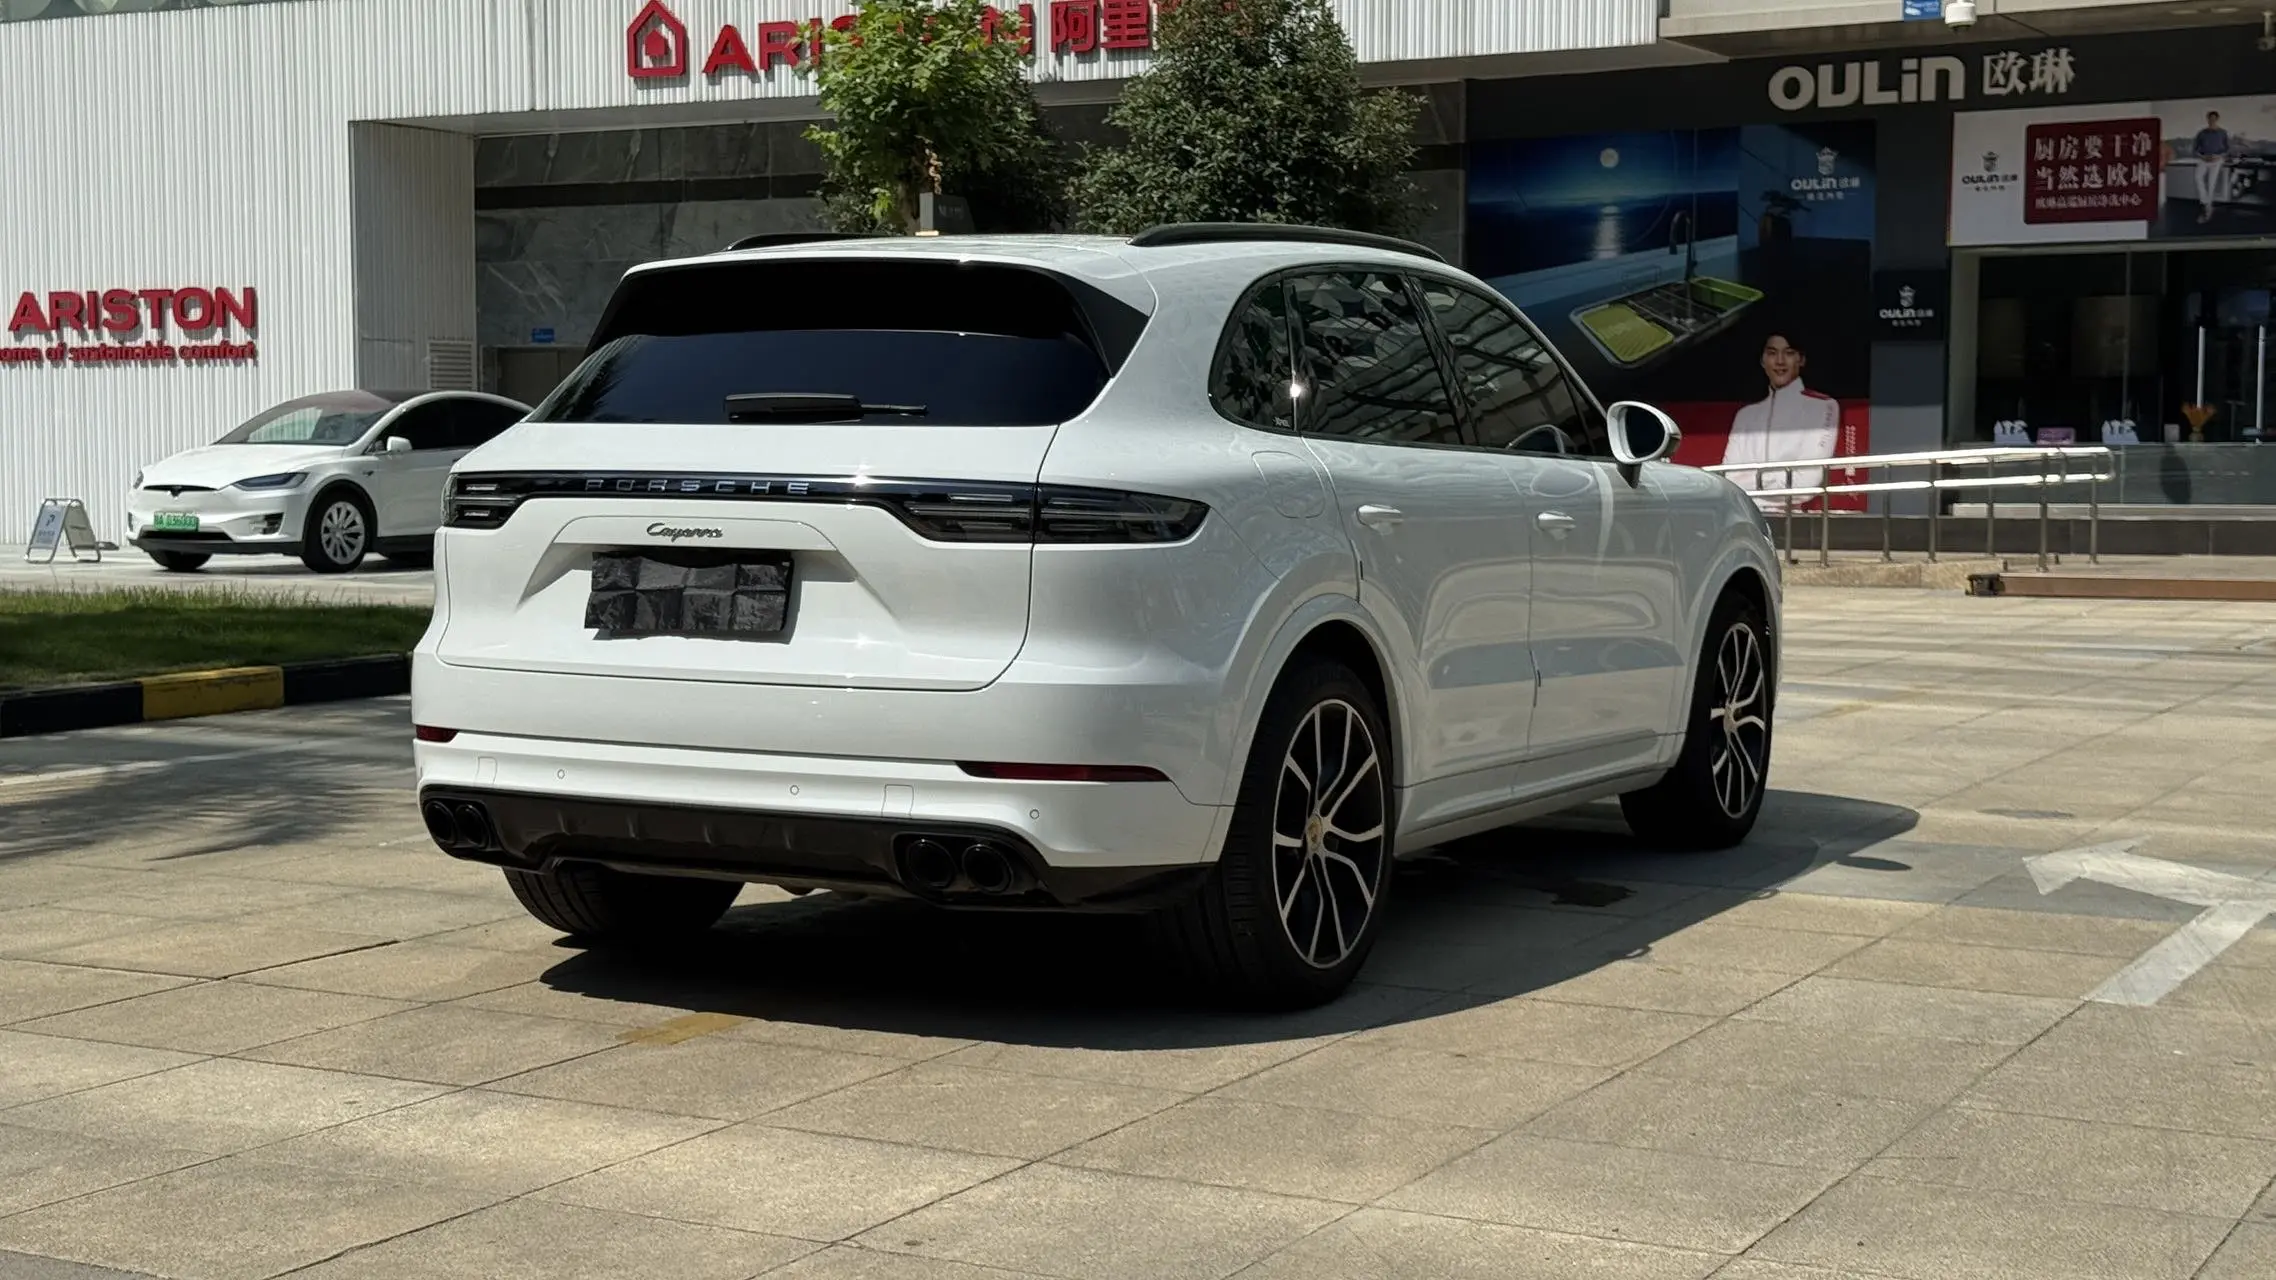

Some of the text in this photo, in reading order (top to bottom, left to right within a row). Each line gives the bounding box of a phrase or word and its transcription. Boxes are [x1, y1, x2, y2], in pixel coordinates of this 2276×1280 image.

[702, 4, 1033, 75] ARIN
[1983, 47, 2076, 96] 欧琳
[2034, 131, 2152, 161] 厨房要干净
[2035, 160, 2154, 191] 当然选欧琳
[8, 287, 257, 332] ARISTON
[0, 339, 257, 363] ome of sustainable comfort
[585, 479, 809, 495] PORSCHE
[646, 522, 724, 543] Cayenne
